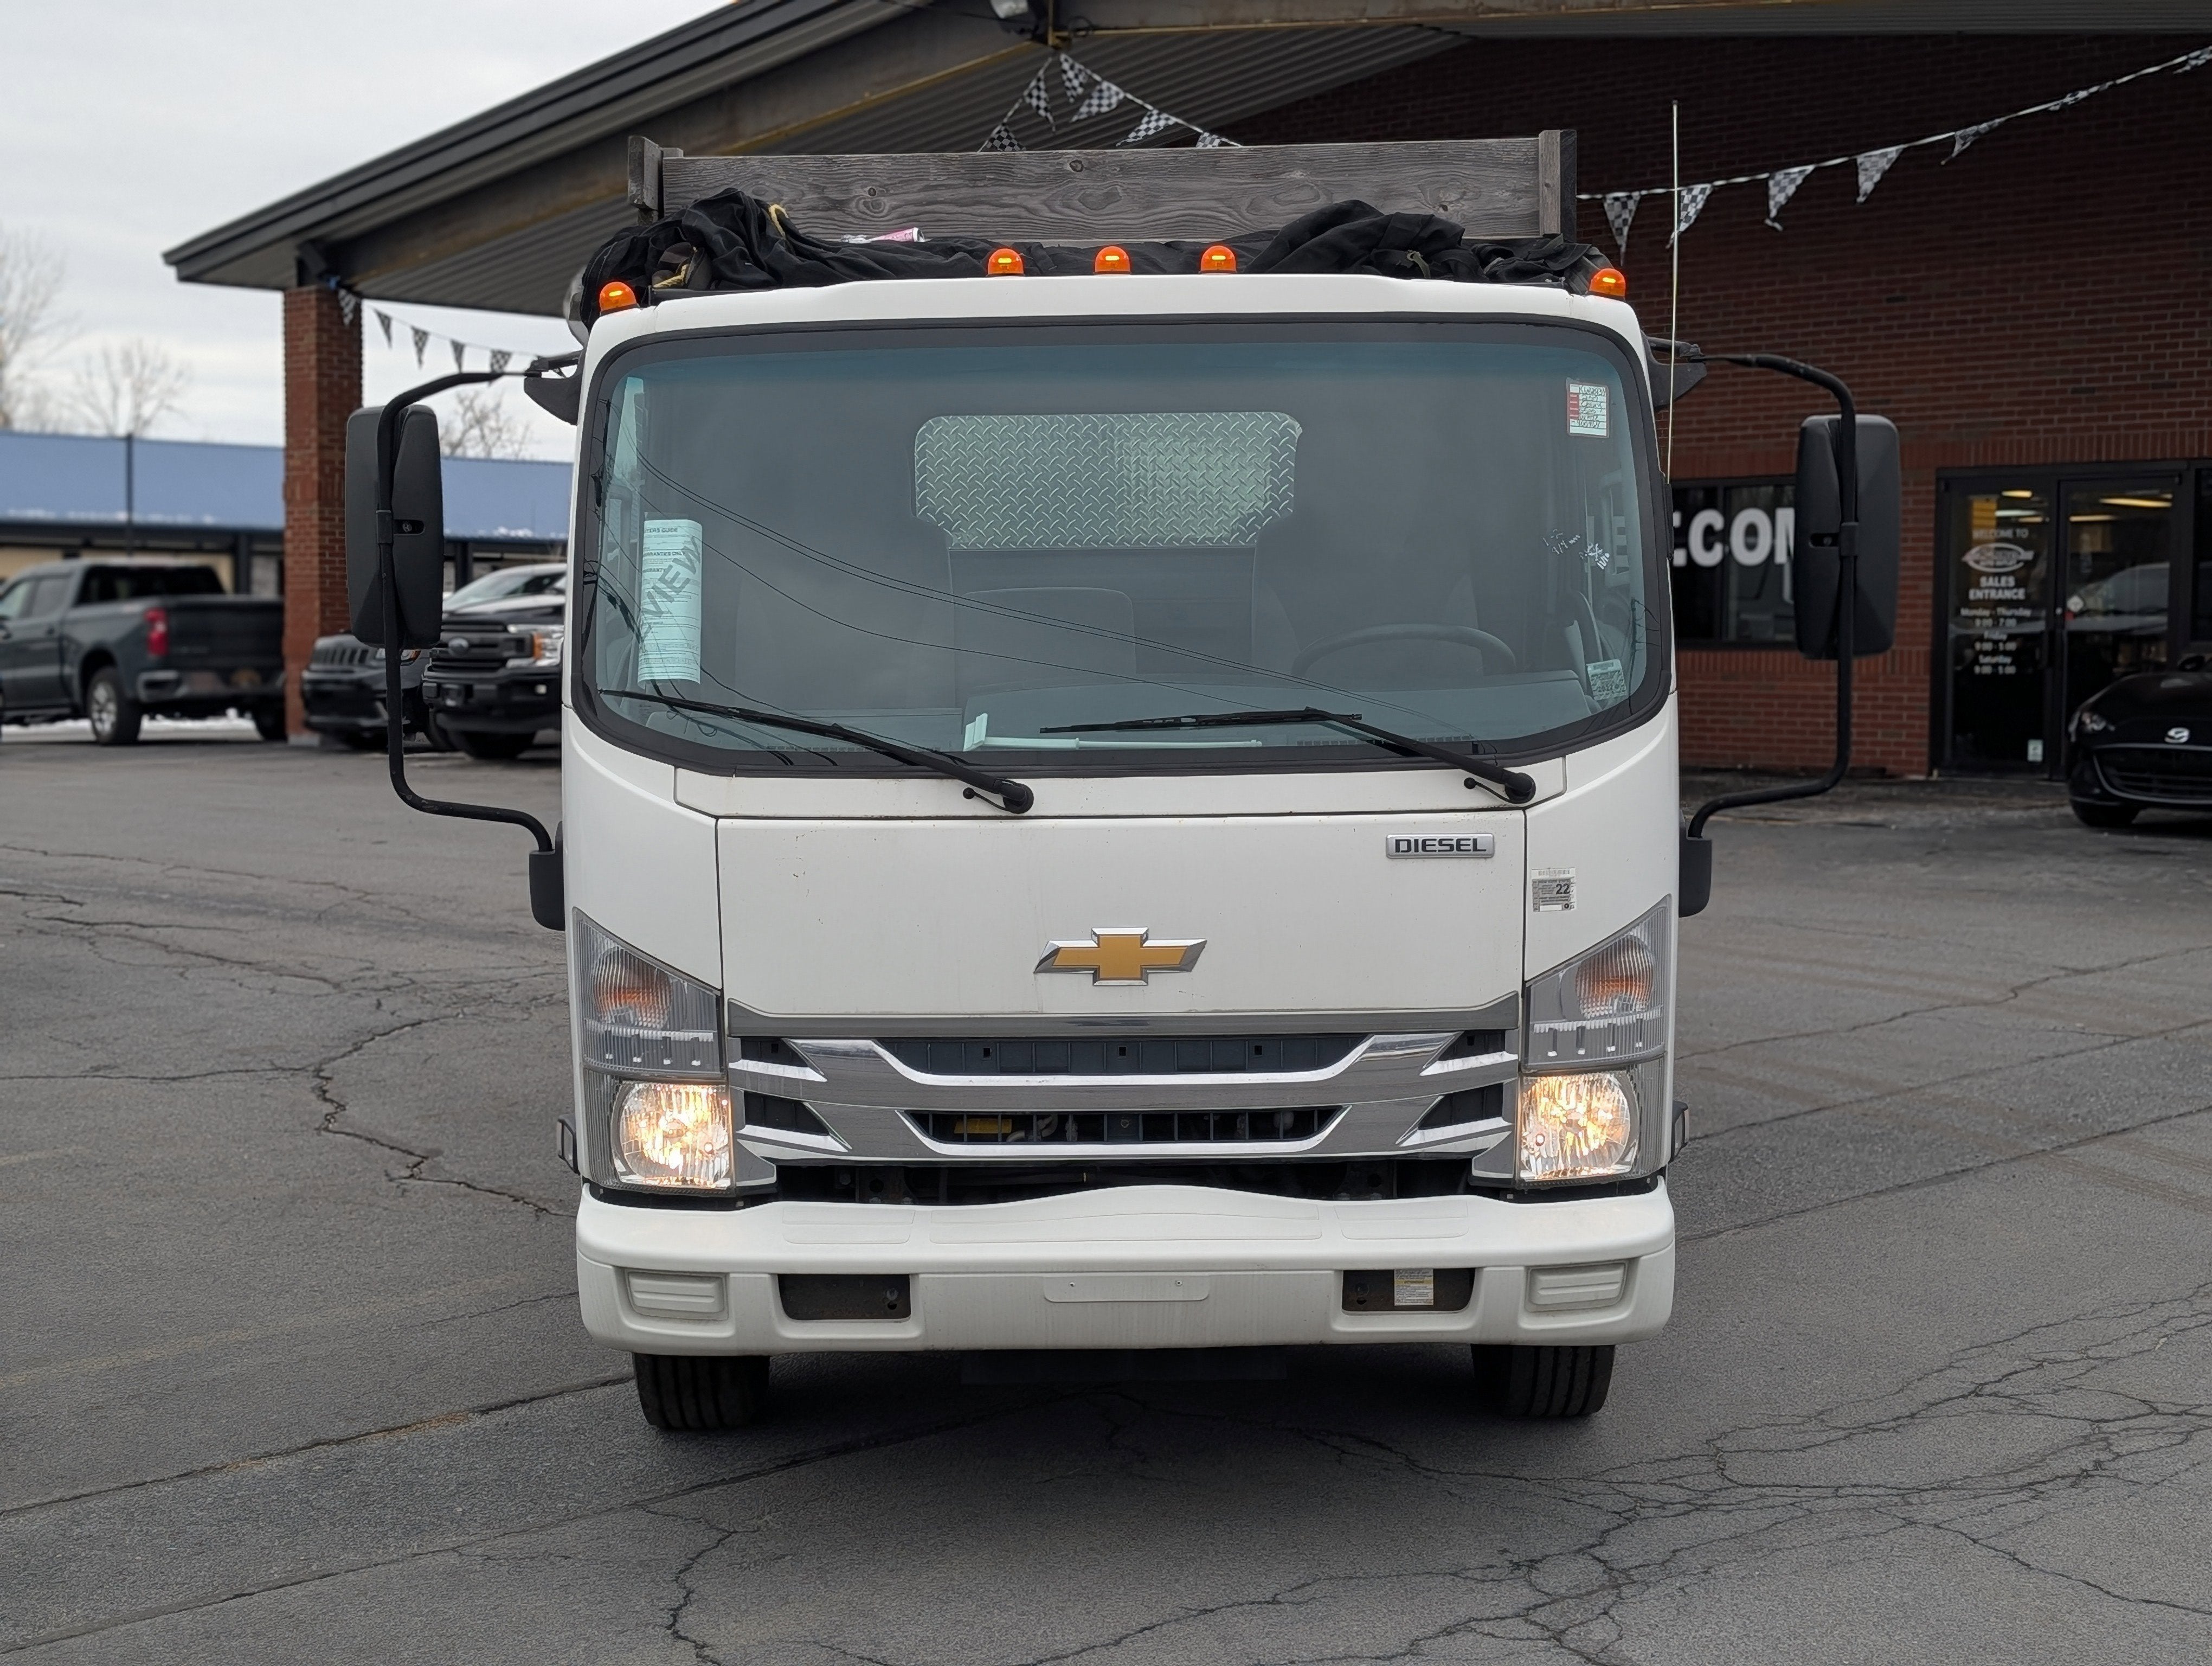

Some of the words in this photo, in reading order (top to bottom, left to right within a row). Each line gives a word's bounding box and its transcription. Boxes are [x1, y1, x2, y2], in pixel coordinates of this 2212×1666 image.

[2015, 527, 2029, 539] TO
[1979, 575, 2016, 588] SALES
[1968, 587, 2026, 601] ENTRANCE
[1983, 630, 2008, 641] Friday
[1978, 654, 2013, 664] Saturday
[1394, 838, 1487, 853] DIESEL
[1555, 883, 1571, 895] 22
